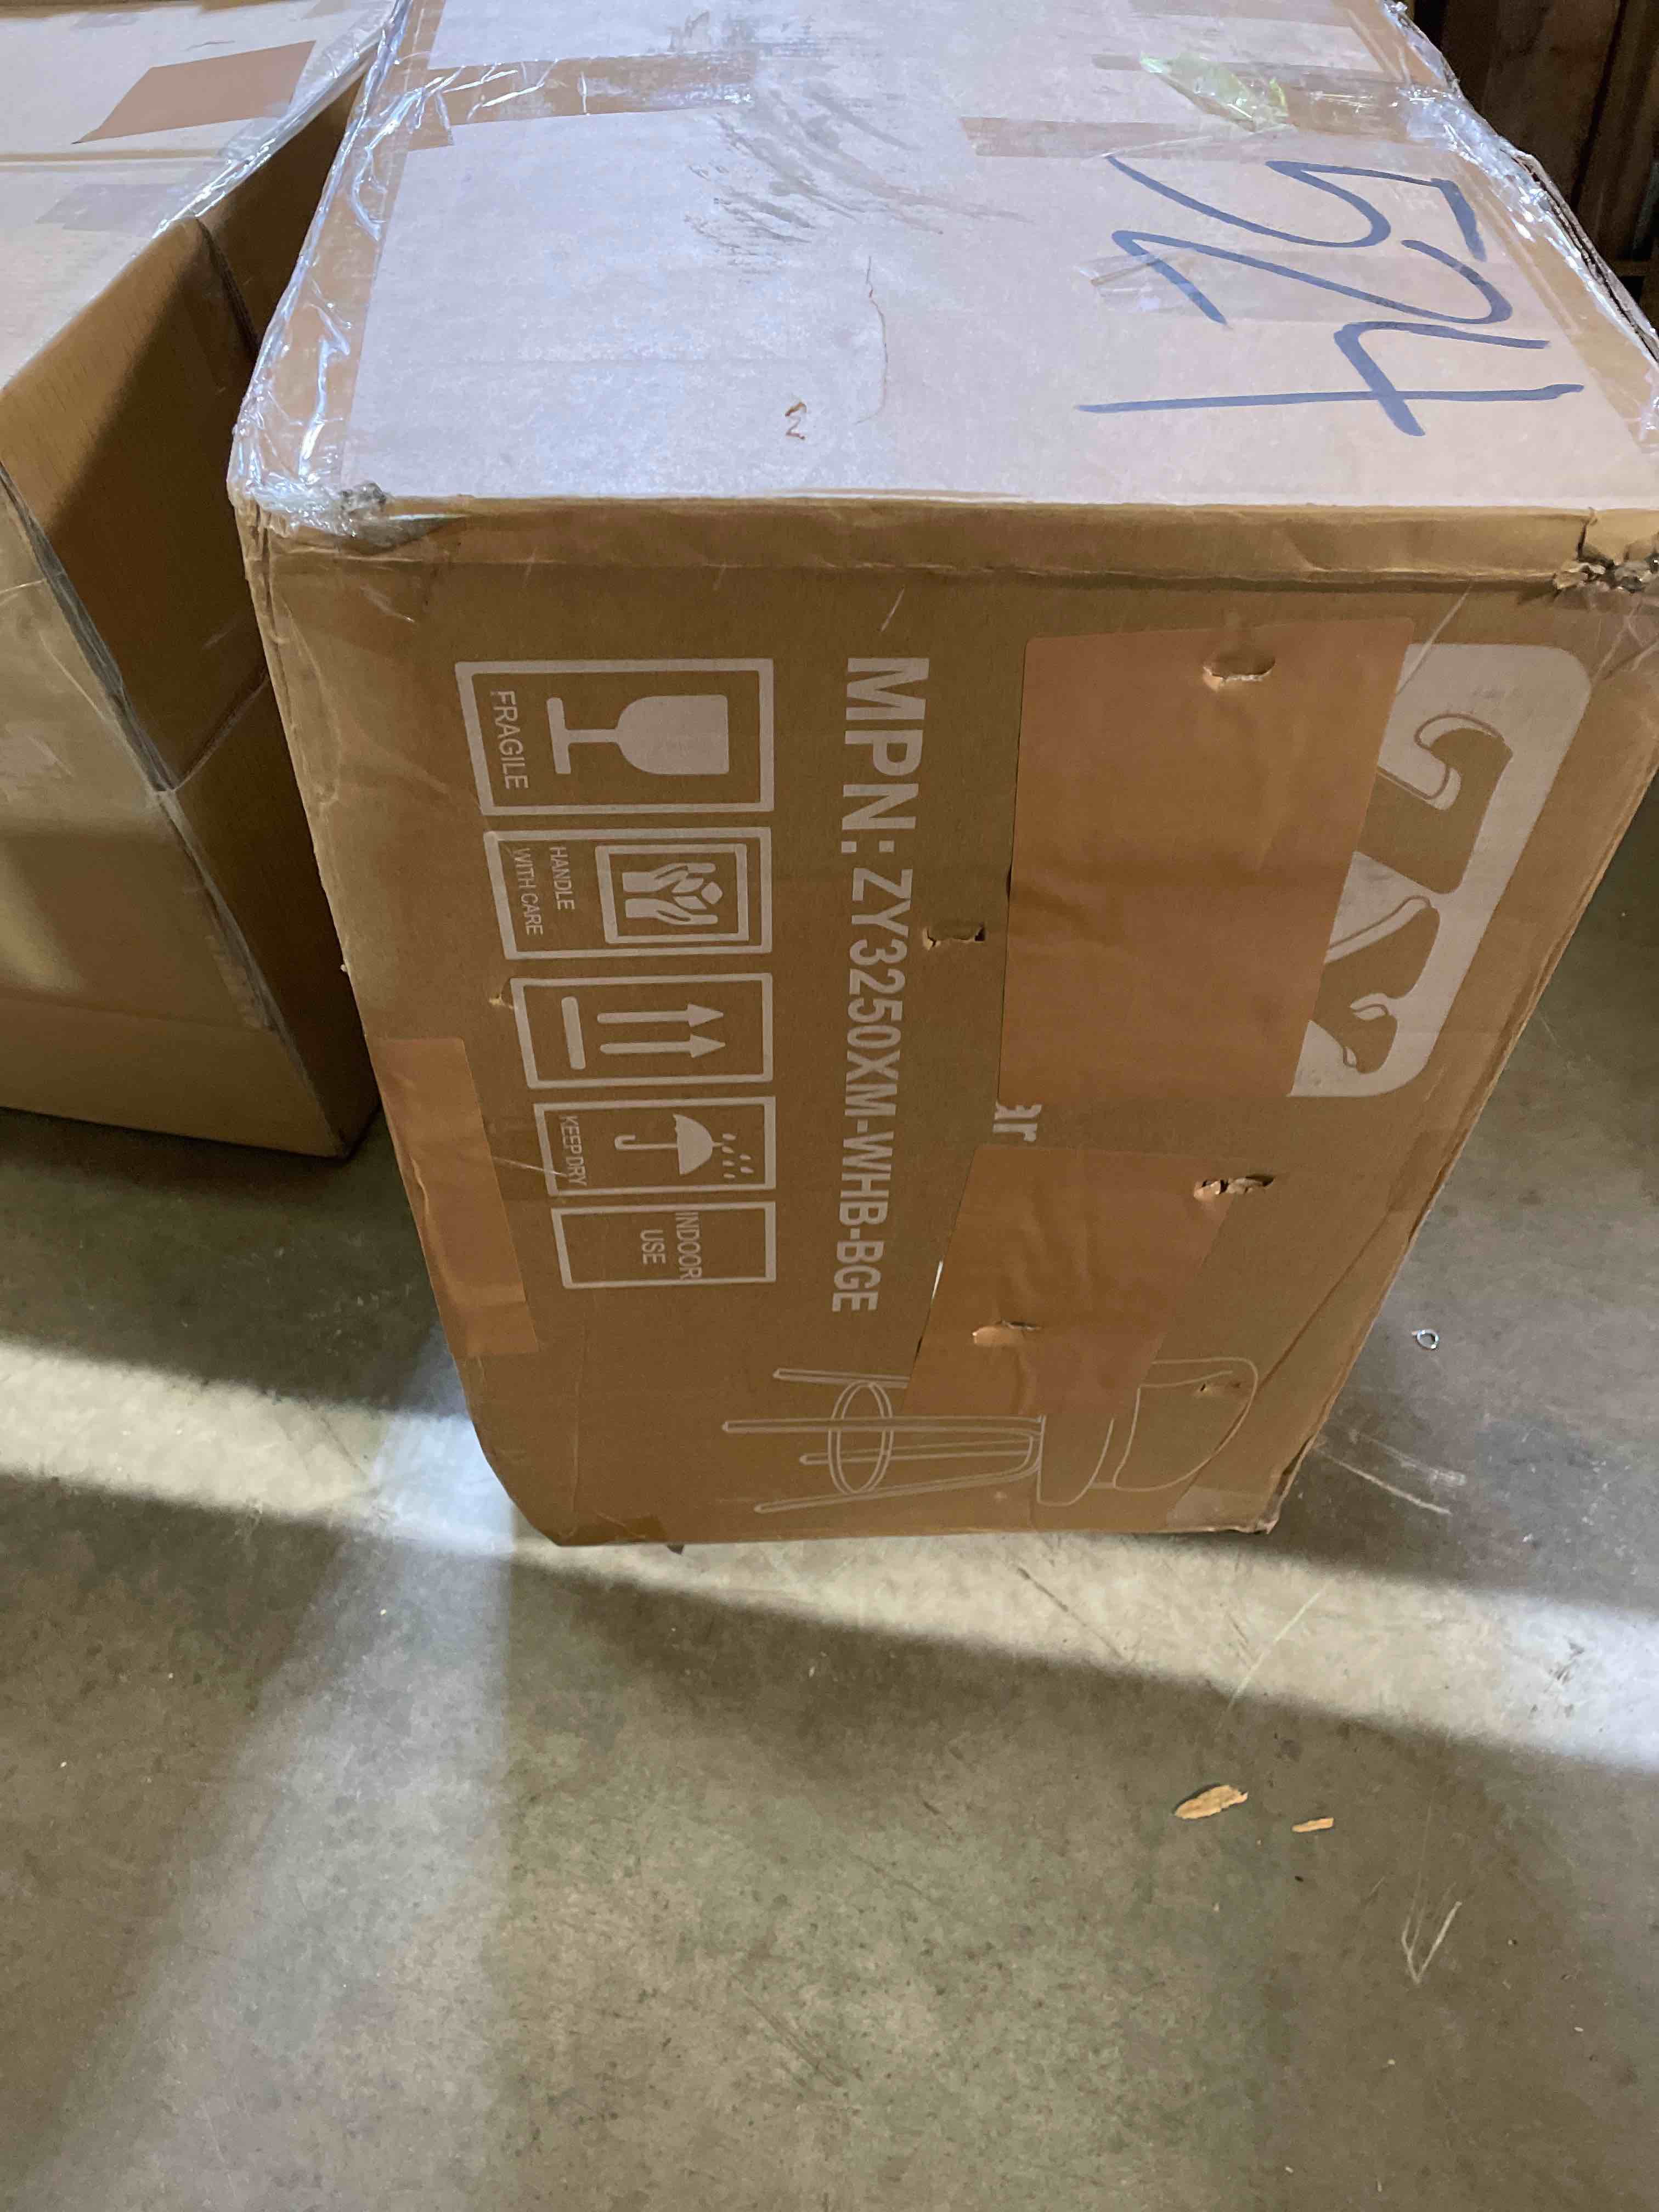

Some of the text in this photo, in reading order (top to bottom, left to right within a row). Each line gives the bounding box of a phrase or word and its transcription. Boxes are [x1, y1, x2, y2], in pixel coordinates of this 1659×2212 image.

[1074, 154, 1584, 437] 524
[490, 690, 529, 790] FRAGILE
[512, 847, 544, 936] WITH CARE
[549, 845, 575, 911] HANDLE
[831, 657, 930, 1312] MPN: ZY3250XM-WHB-BGE
[558, 1114, 588, 1187] KEEP DRY
[639, 1228, 667, 1265] USE
[675, 1210, 703, 1280] INDOOR
